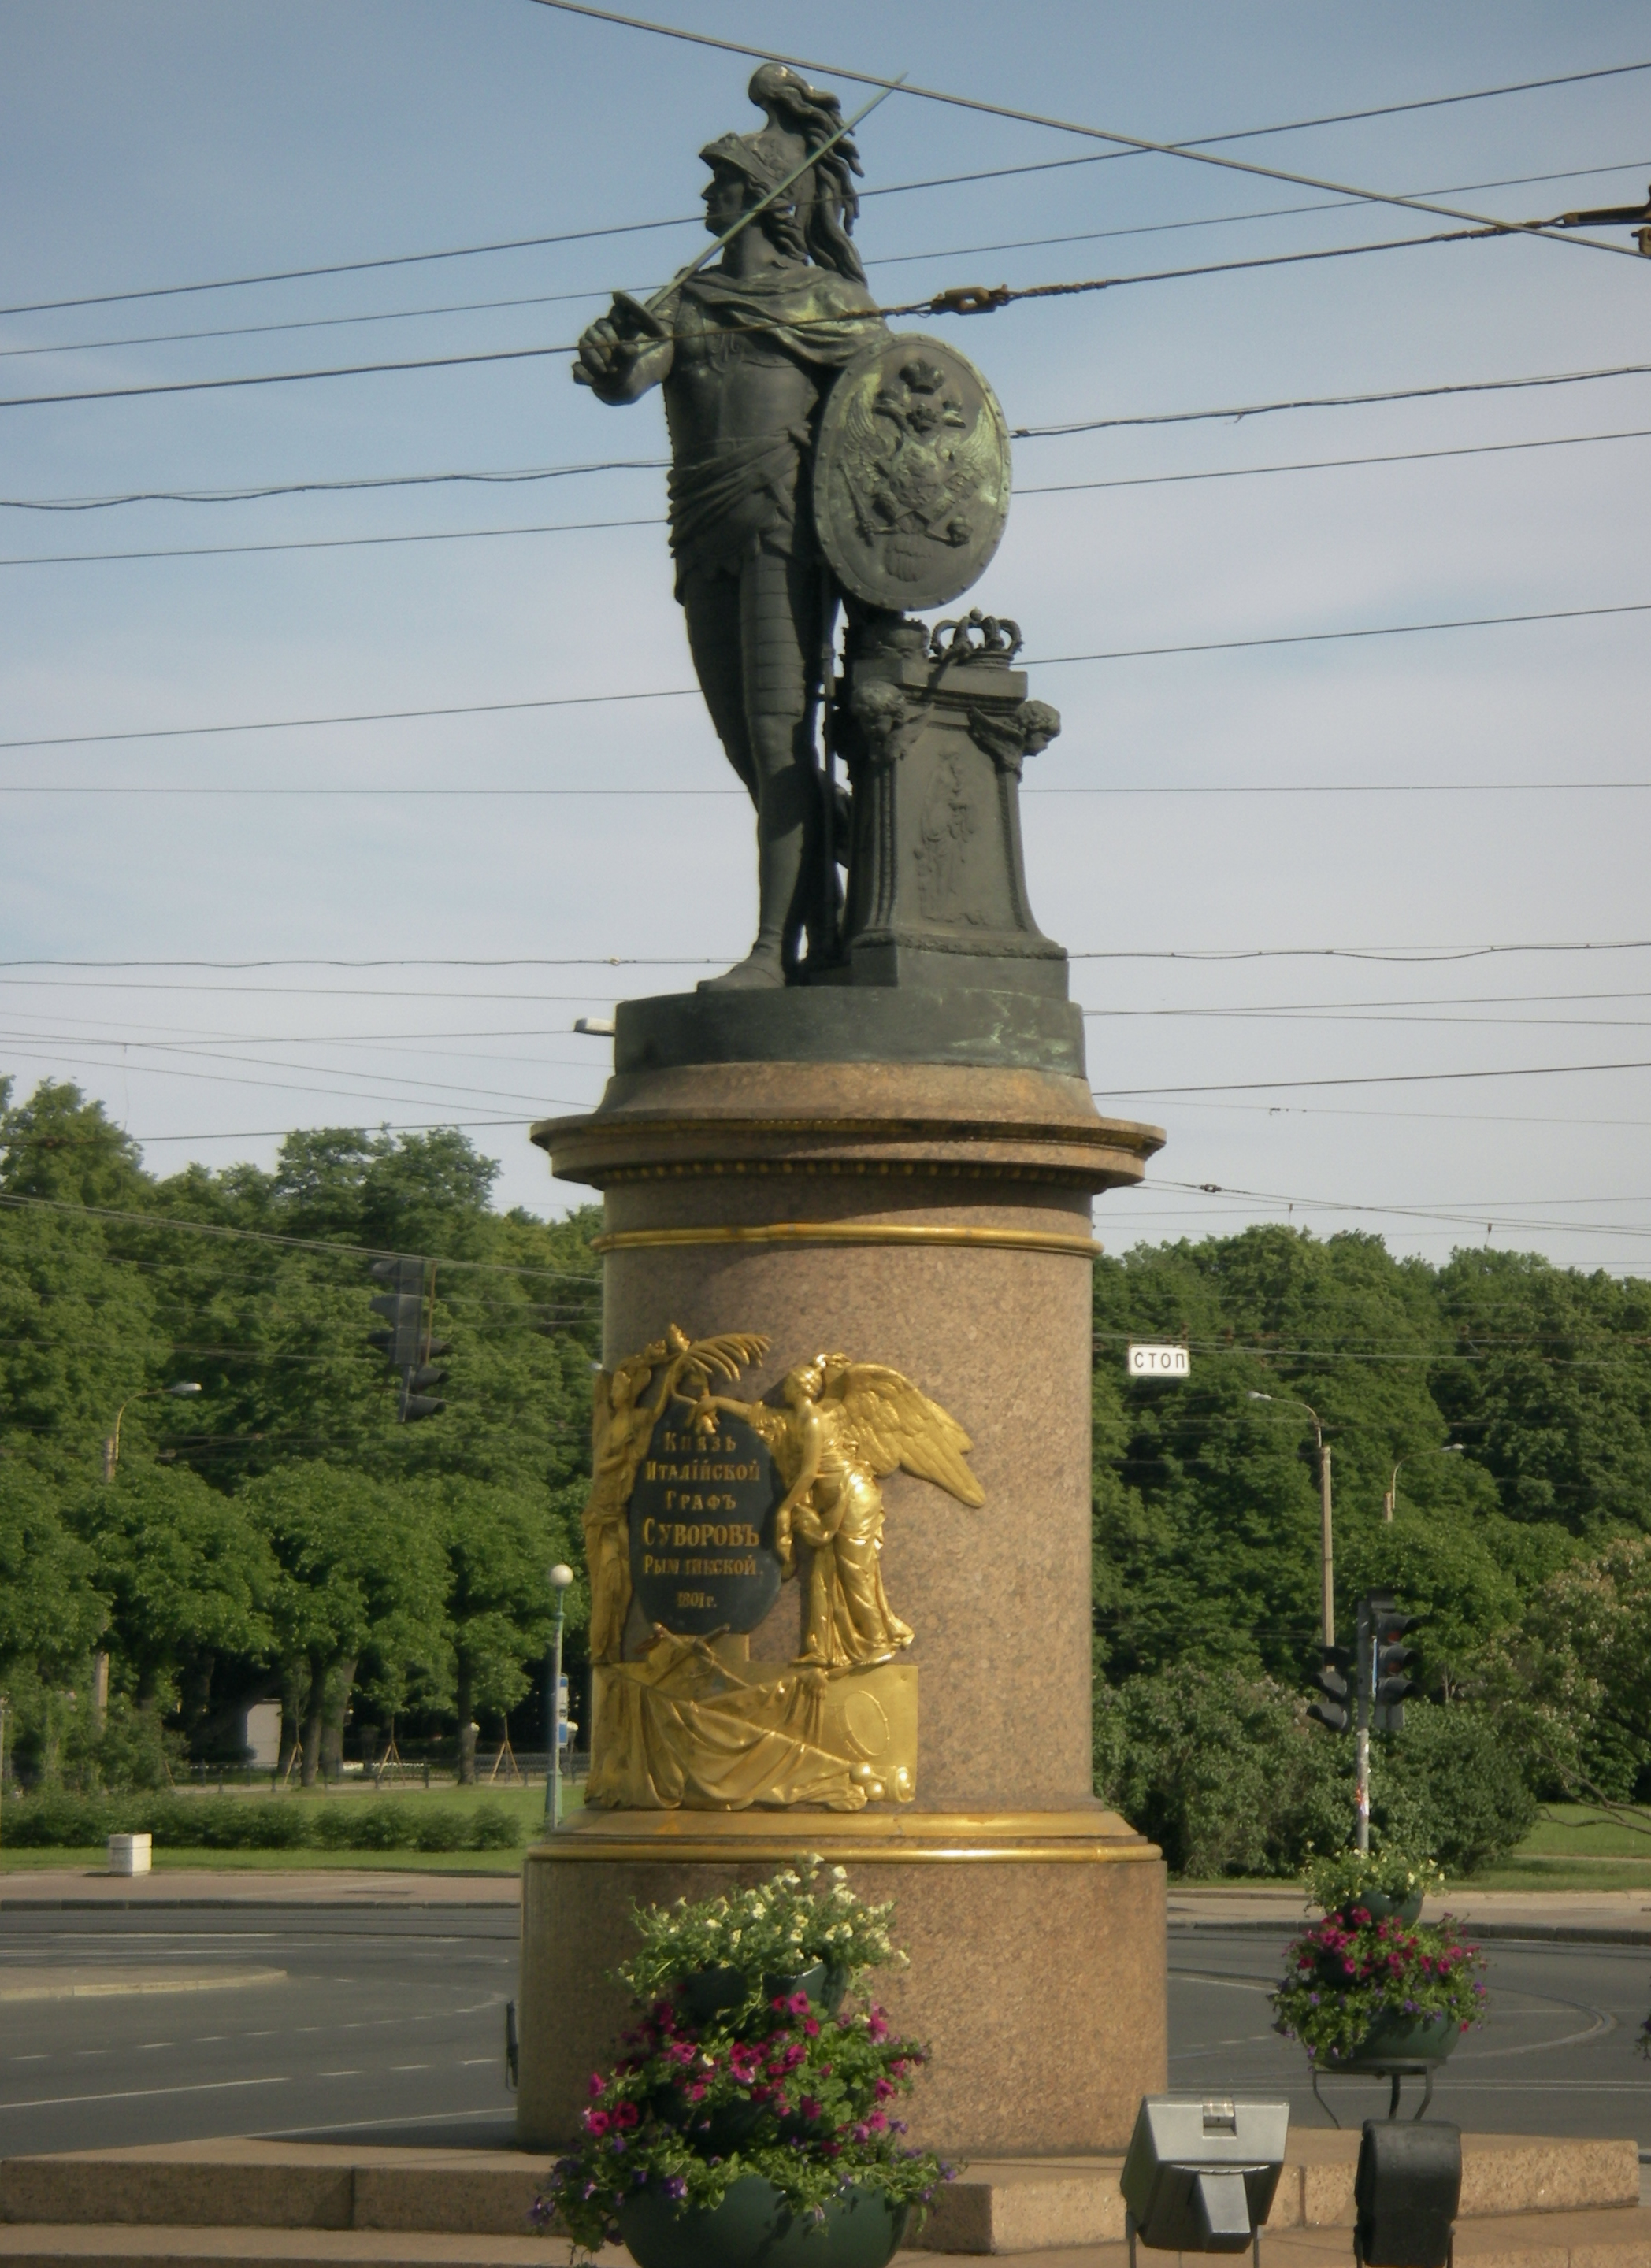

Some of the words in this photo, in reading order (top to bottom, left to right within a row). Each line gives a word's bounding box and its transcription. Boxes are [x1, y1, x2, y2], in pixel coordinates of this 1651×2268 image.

[1134, 1351, 1185, 1369] СТОП
[666, 1490, 736, 1510] ГРАФЪ
[644, 1518, 760, 1547] СУВОРОВЪ
